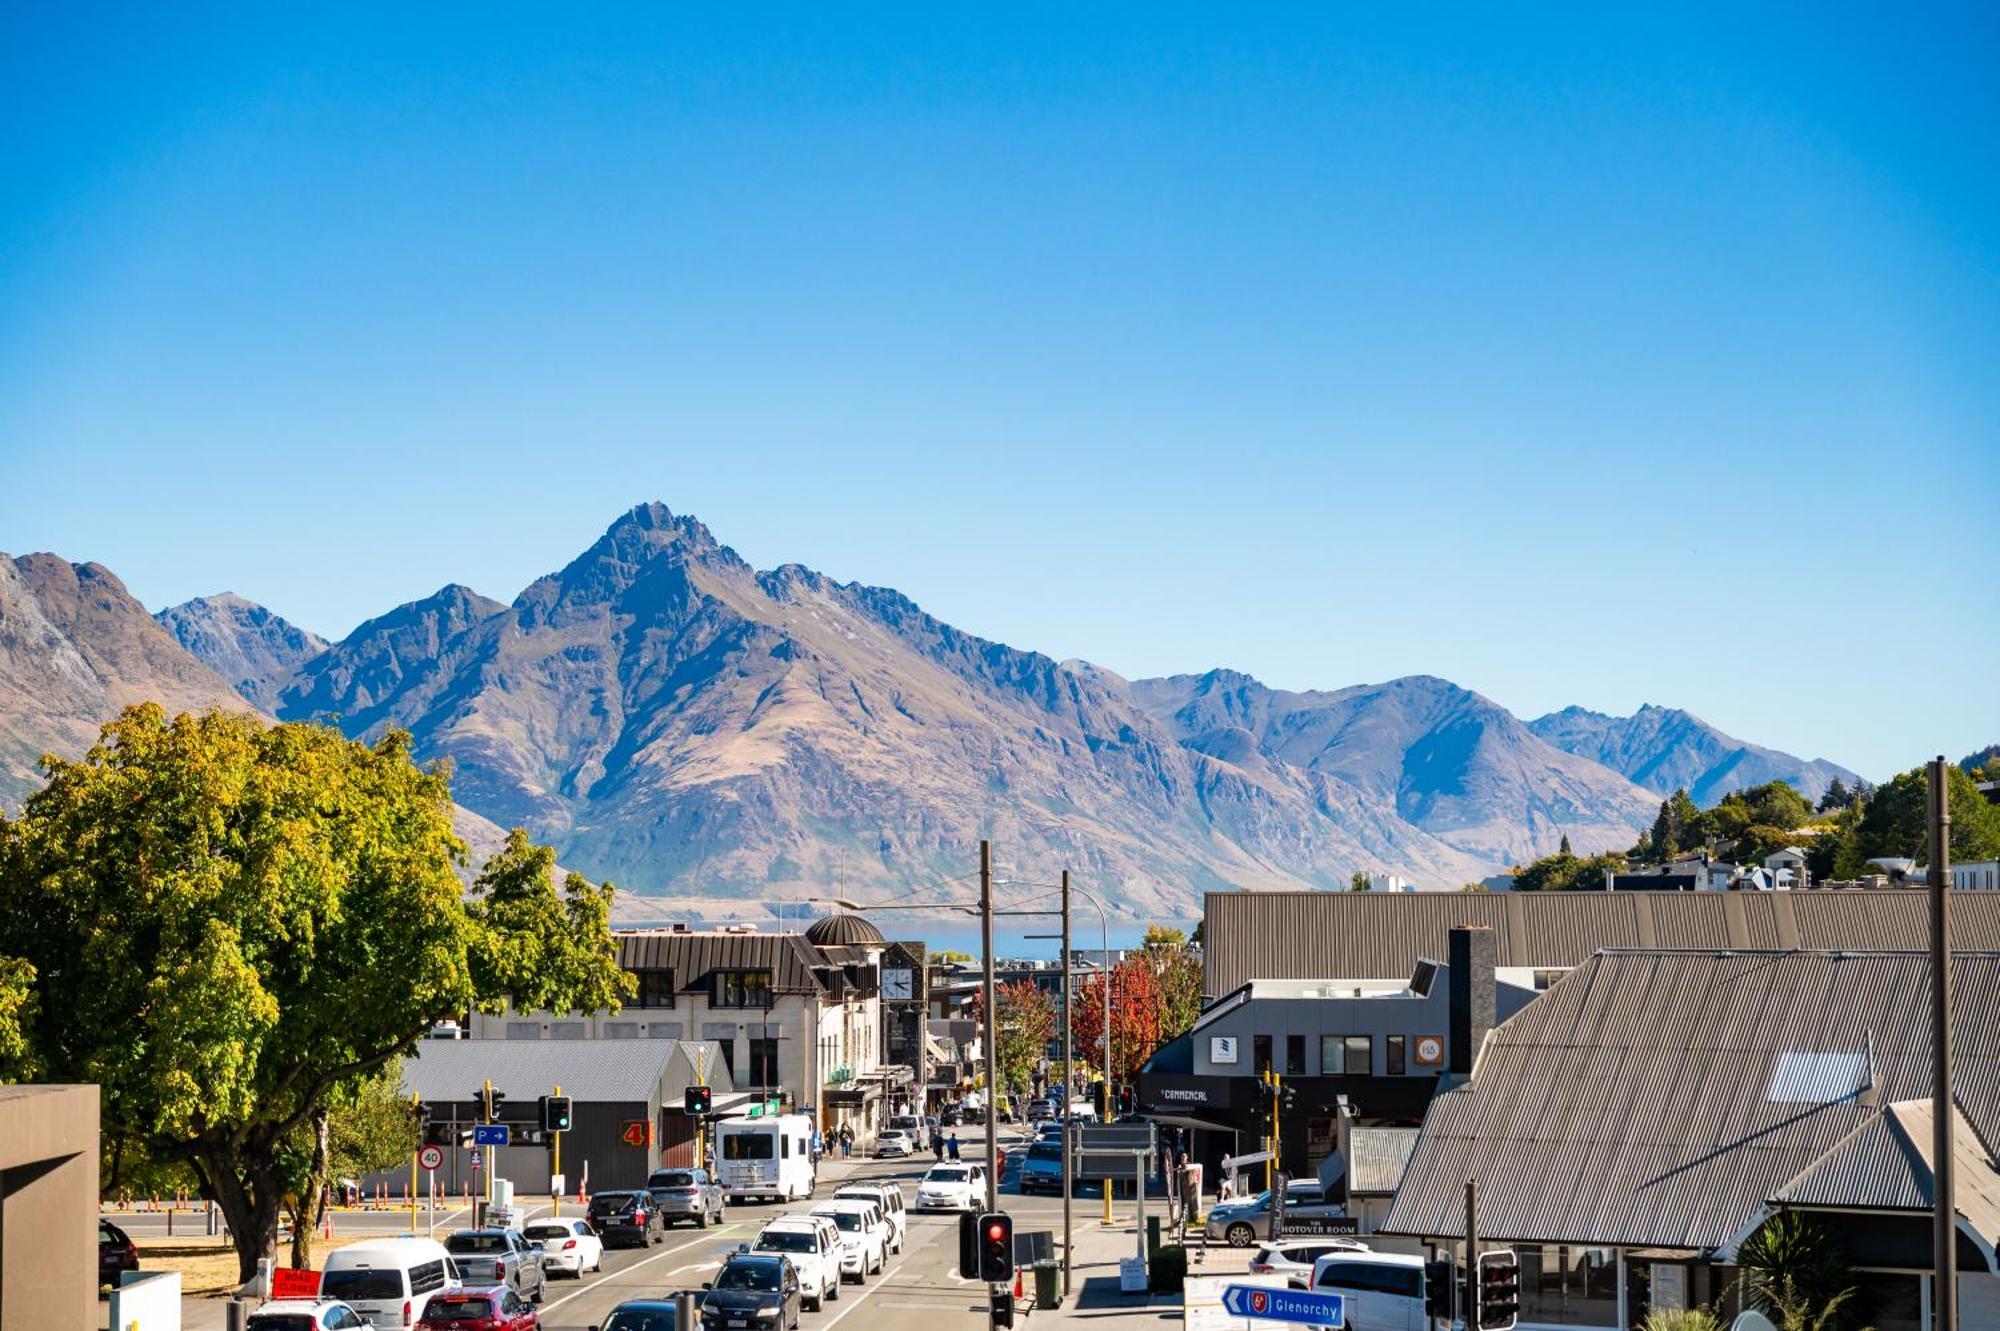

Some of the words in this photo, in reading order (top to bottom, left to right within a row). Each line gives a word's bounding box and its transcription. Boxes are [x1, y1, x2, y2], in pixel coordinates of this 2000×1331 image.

[478, 1130, 487, 1140] P
[424, 1153, 438, 1163] 40
[1326, 1226, 1355, 1234] ROOM
[285, 1272, 311, 1281] ROAD
[1275, 1299, 1337, 1319] Glenorchy
